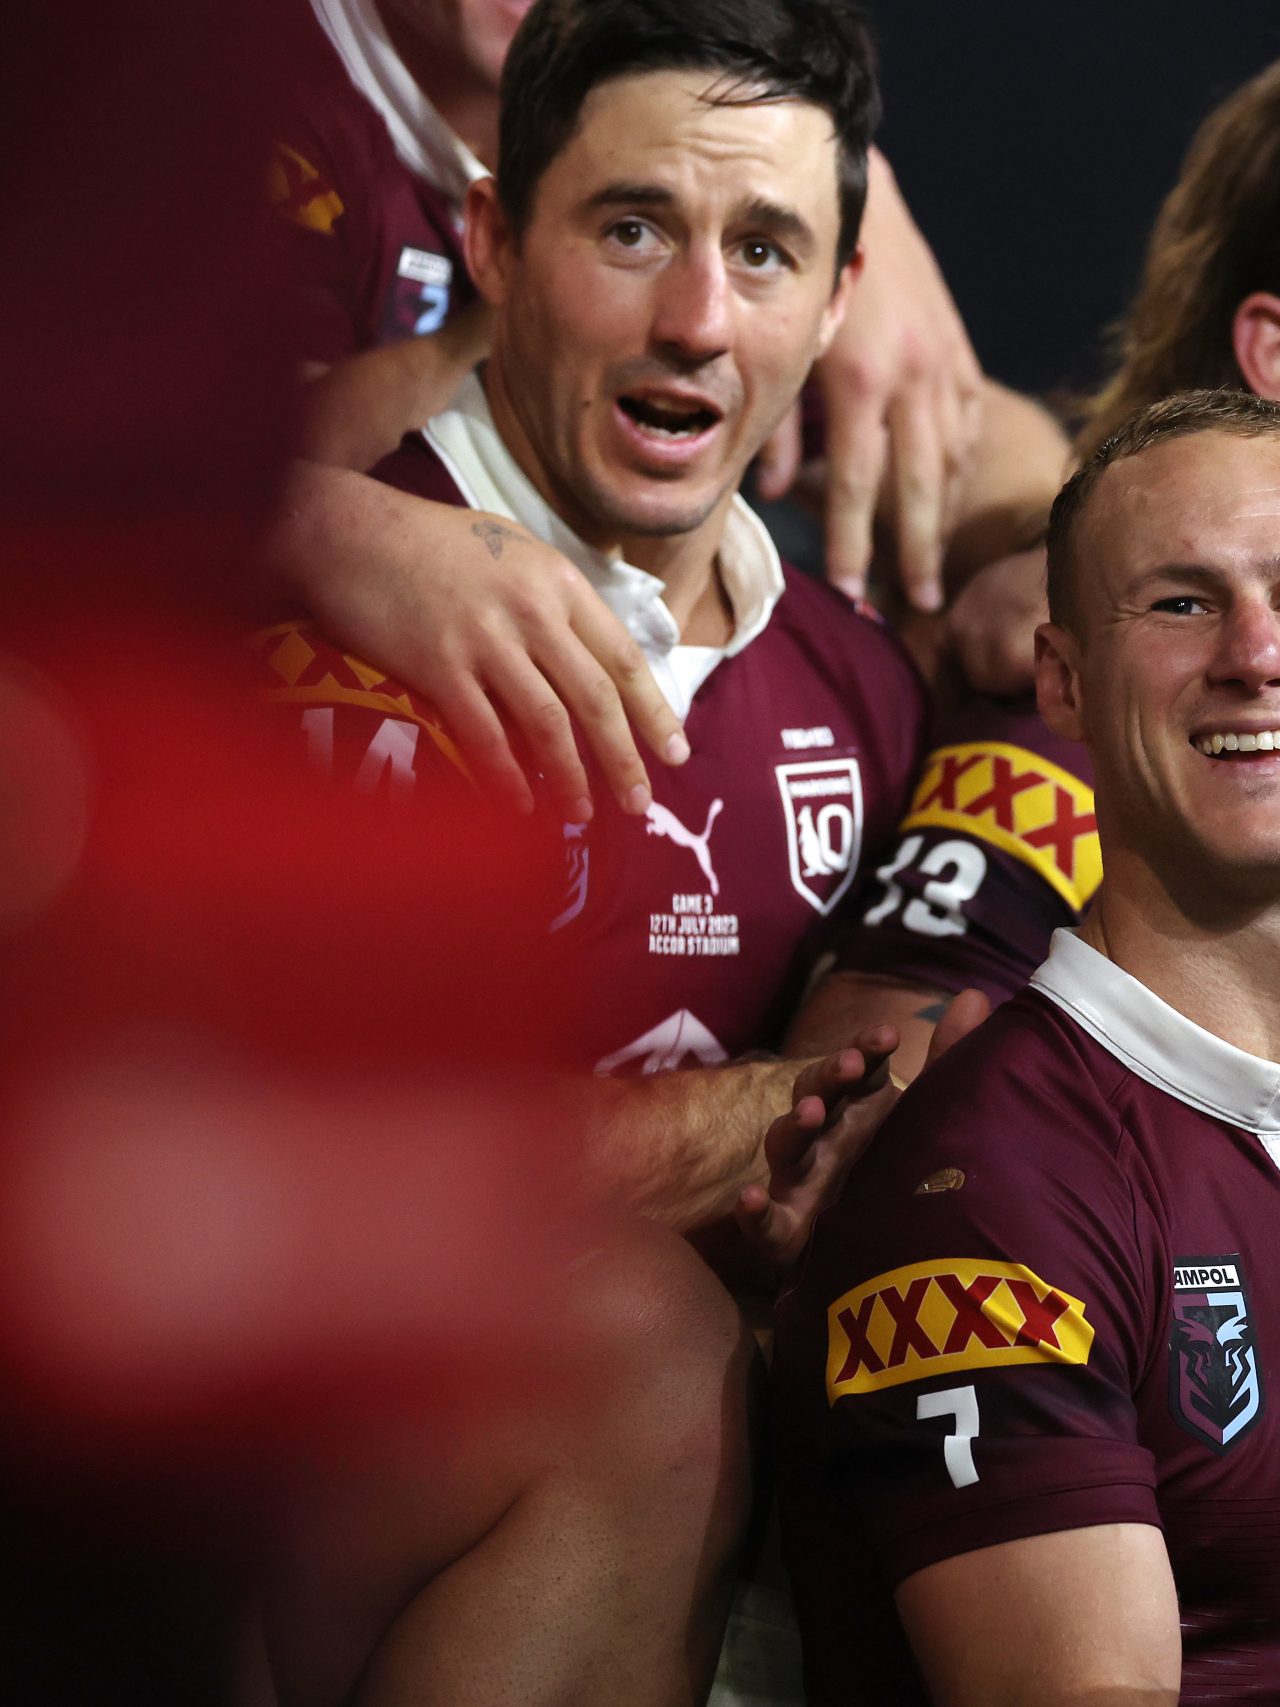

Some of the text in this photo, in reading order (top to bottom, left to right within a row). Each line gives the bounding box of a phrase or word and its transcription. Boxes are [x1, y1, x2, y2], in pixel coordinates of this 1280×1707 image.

[672, 893, 703, 914] GAME
[650, 914, 677, 934] 12TH
[678, 915, 706, 935] JULY
[1174, 1268, 1235, 1286] AMPOL
[834, 1273, 1070, 1384] XXXX
[917, 1385, 980, 1489] 7
